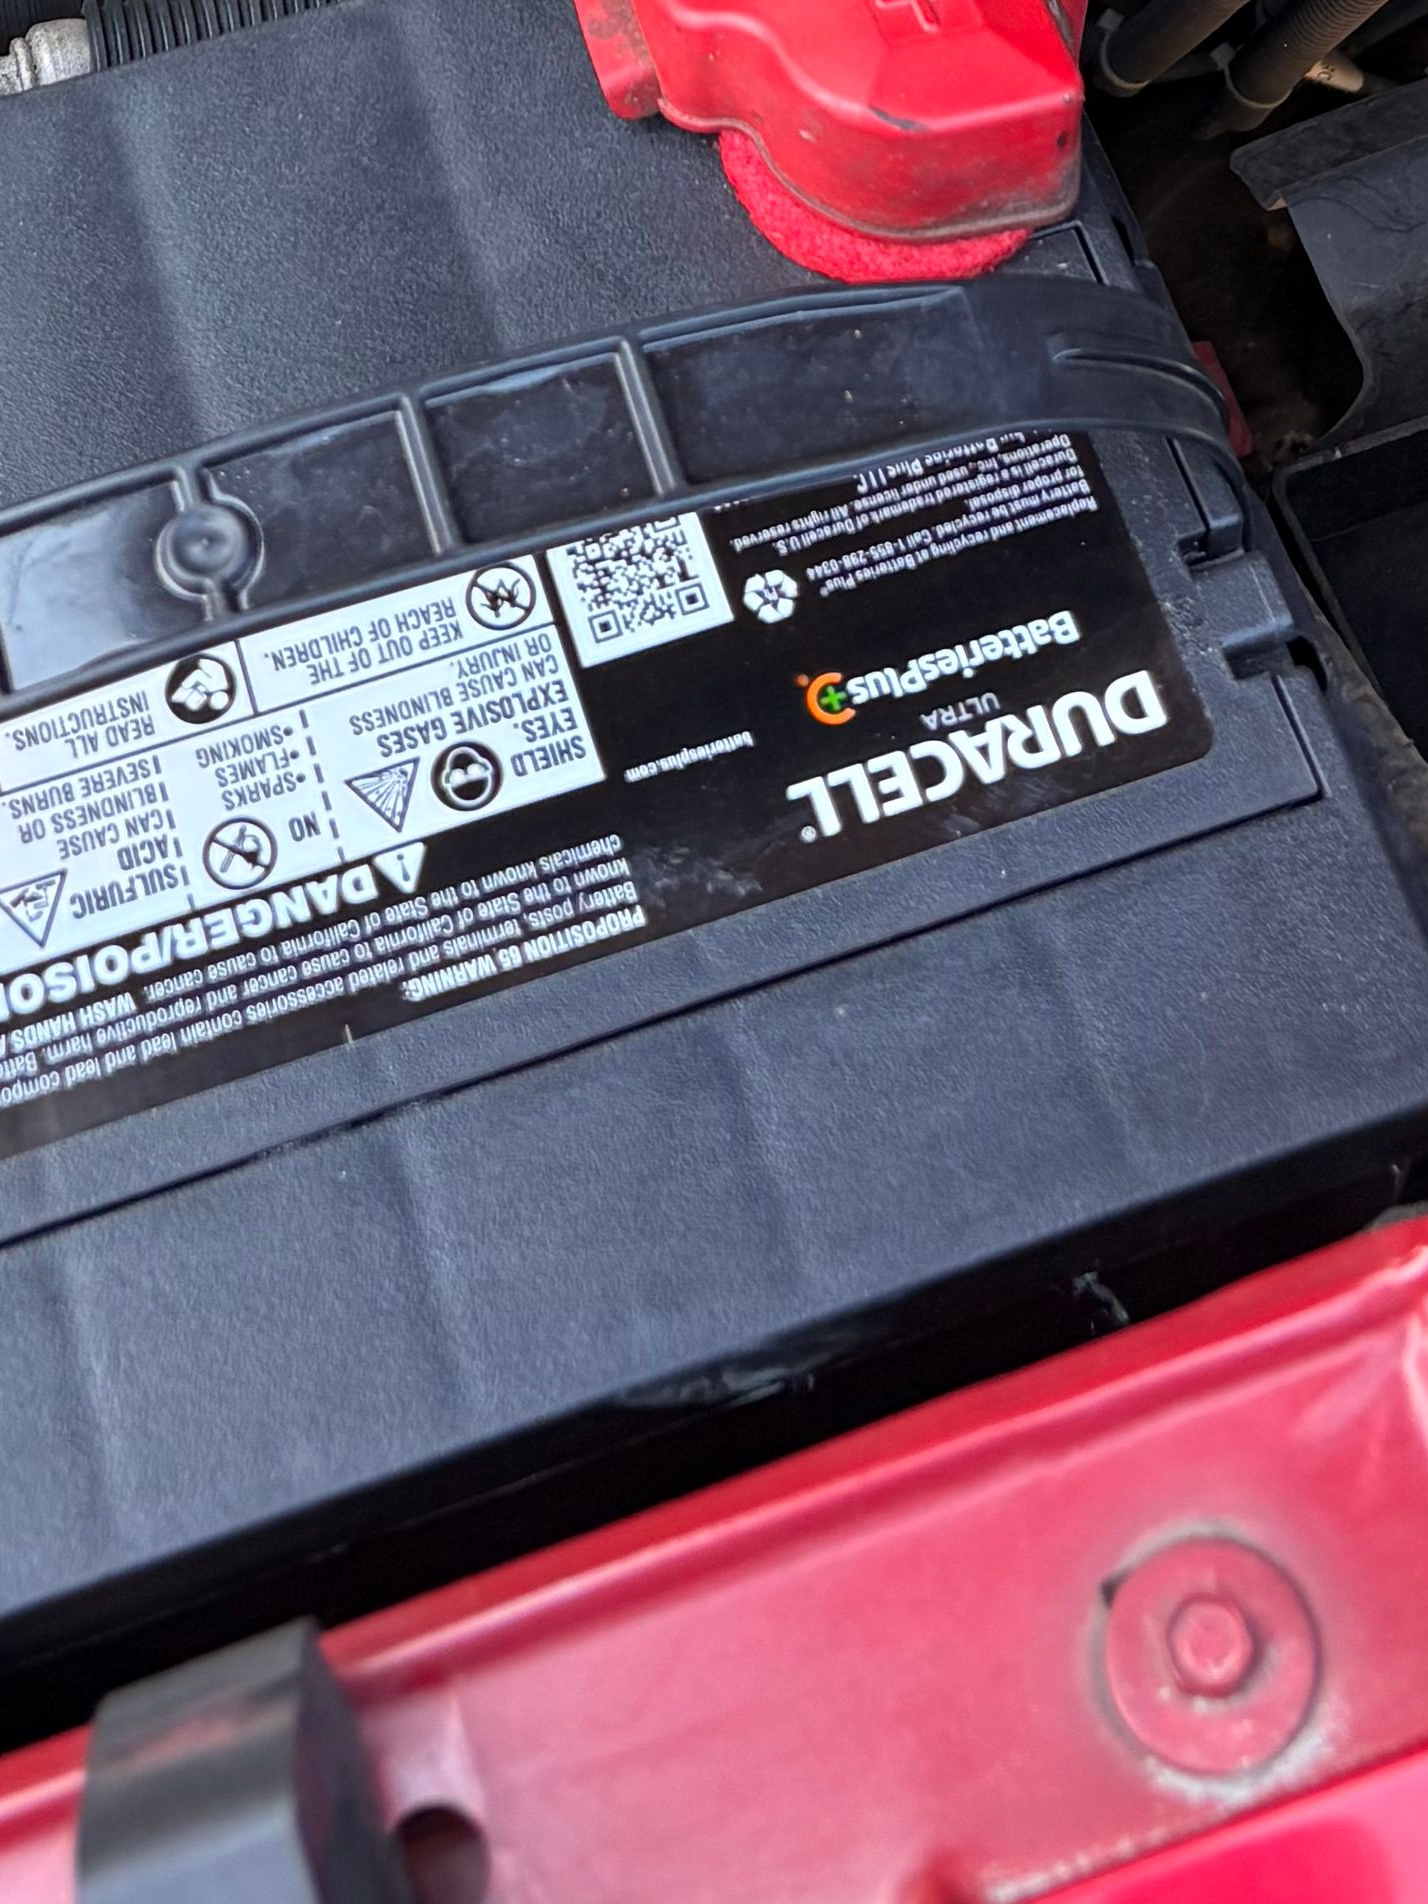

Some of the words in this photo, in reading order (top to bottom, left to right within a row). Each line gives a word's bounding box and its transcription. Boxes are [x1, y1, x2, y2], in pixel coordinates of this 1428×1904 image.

[987, 519, 1016, 542] and
[1011, 490, 1099, 535] Replacement
[913, 547, 930, 565] at
[928, 524, 991, 561] recycling
[853, 551, 916, 585] Batteries
[363, 615, 392, 642] OF
[392, 594, 455, 633] REACH
[263, 621, 364, 675] CHILDREN.
[374, 633, 414, 665] OUT
[415, 617, 463, 652] KEEP
[523, 631, 552, 658] OR
[305, 653, 345, 686] THE
[345, 646, 374, 674] OF
[448, 637, 522, 682] INJURY.
[519, 651, 559, 681] CAN
[455, 664, 518, 702] CAUSE
[3, 686, 149, 756] INSTRUCTIONS.
[347, 683, 454, 738] BLINDNESS
[449, 676, 568, 736] EXPLOSIVE
[511, 702, 578, 747] EYES.
[917, 688, 1000, 734] ULTRA
[63, 729, 101, 761] ALL
[102, 712, 155, 749] READ
[193, 720, 284, 770] SMOKING
[374, 714, 448, 759] GASES
[212, 745, 290, 789] FLAMES
[508, 731, 587, 780] SHIELD
[621, 725, 755, 788] batteriesplus.com
[77, 755, 150, 798] SEVERE
[220, 767, 296, 812] SPARKS
[0, 778, 75, 823] BURNS.
[49, 780, 157, 835] BLINDNESS
[17, 816, 47, 845] OR
[55, 820, 120, 860] CAUSE
[123, 806, 164, 838] CAN
[286, 810, 320, 843] NO
[115, 832, 171, 873] ACID
[67, 861, 178, 921] SULFURIC
[575, 875, 637, 916] Battery
[520, 895, 575, 934] posts,
[524, 901, 646, 963] PROPOSITION
[405, 941, 441, 972] and
[440, 915, 522, 961] terminals
[496, 942, 523, 971] 65
[345, 953, 406, 992] related
[400, 951, 497, 1004] WARNING:
[77, 989, 136, 1028] WASH
[244, 973, 346, 1026] accessories
[8, 1009, 76, 1051] HANDS
[142, 1028, 177, 1059] lead
[177, 1006, 244, 1048] contain
[62, 1054, 102, 1086] lead
[102, 1041, 138, 1073] and
